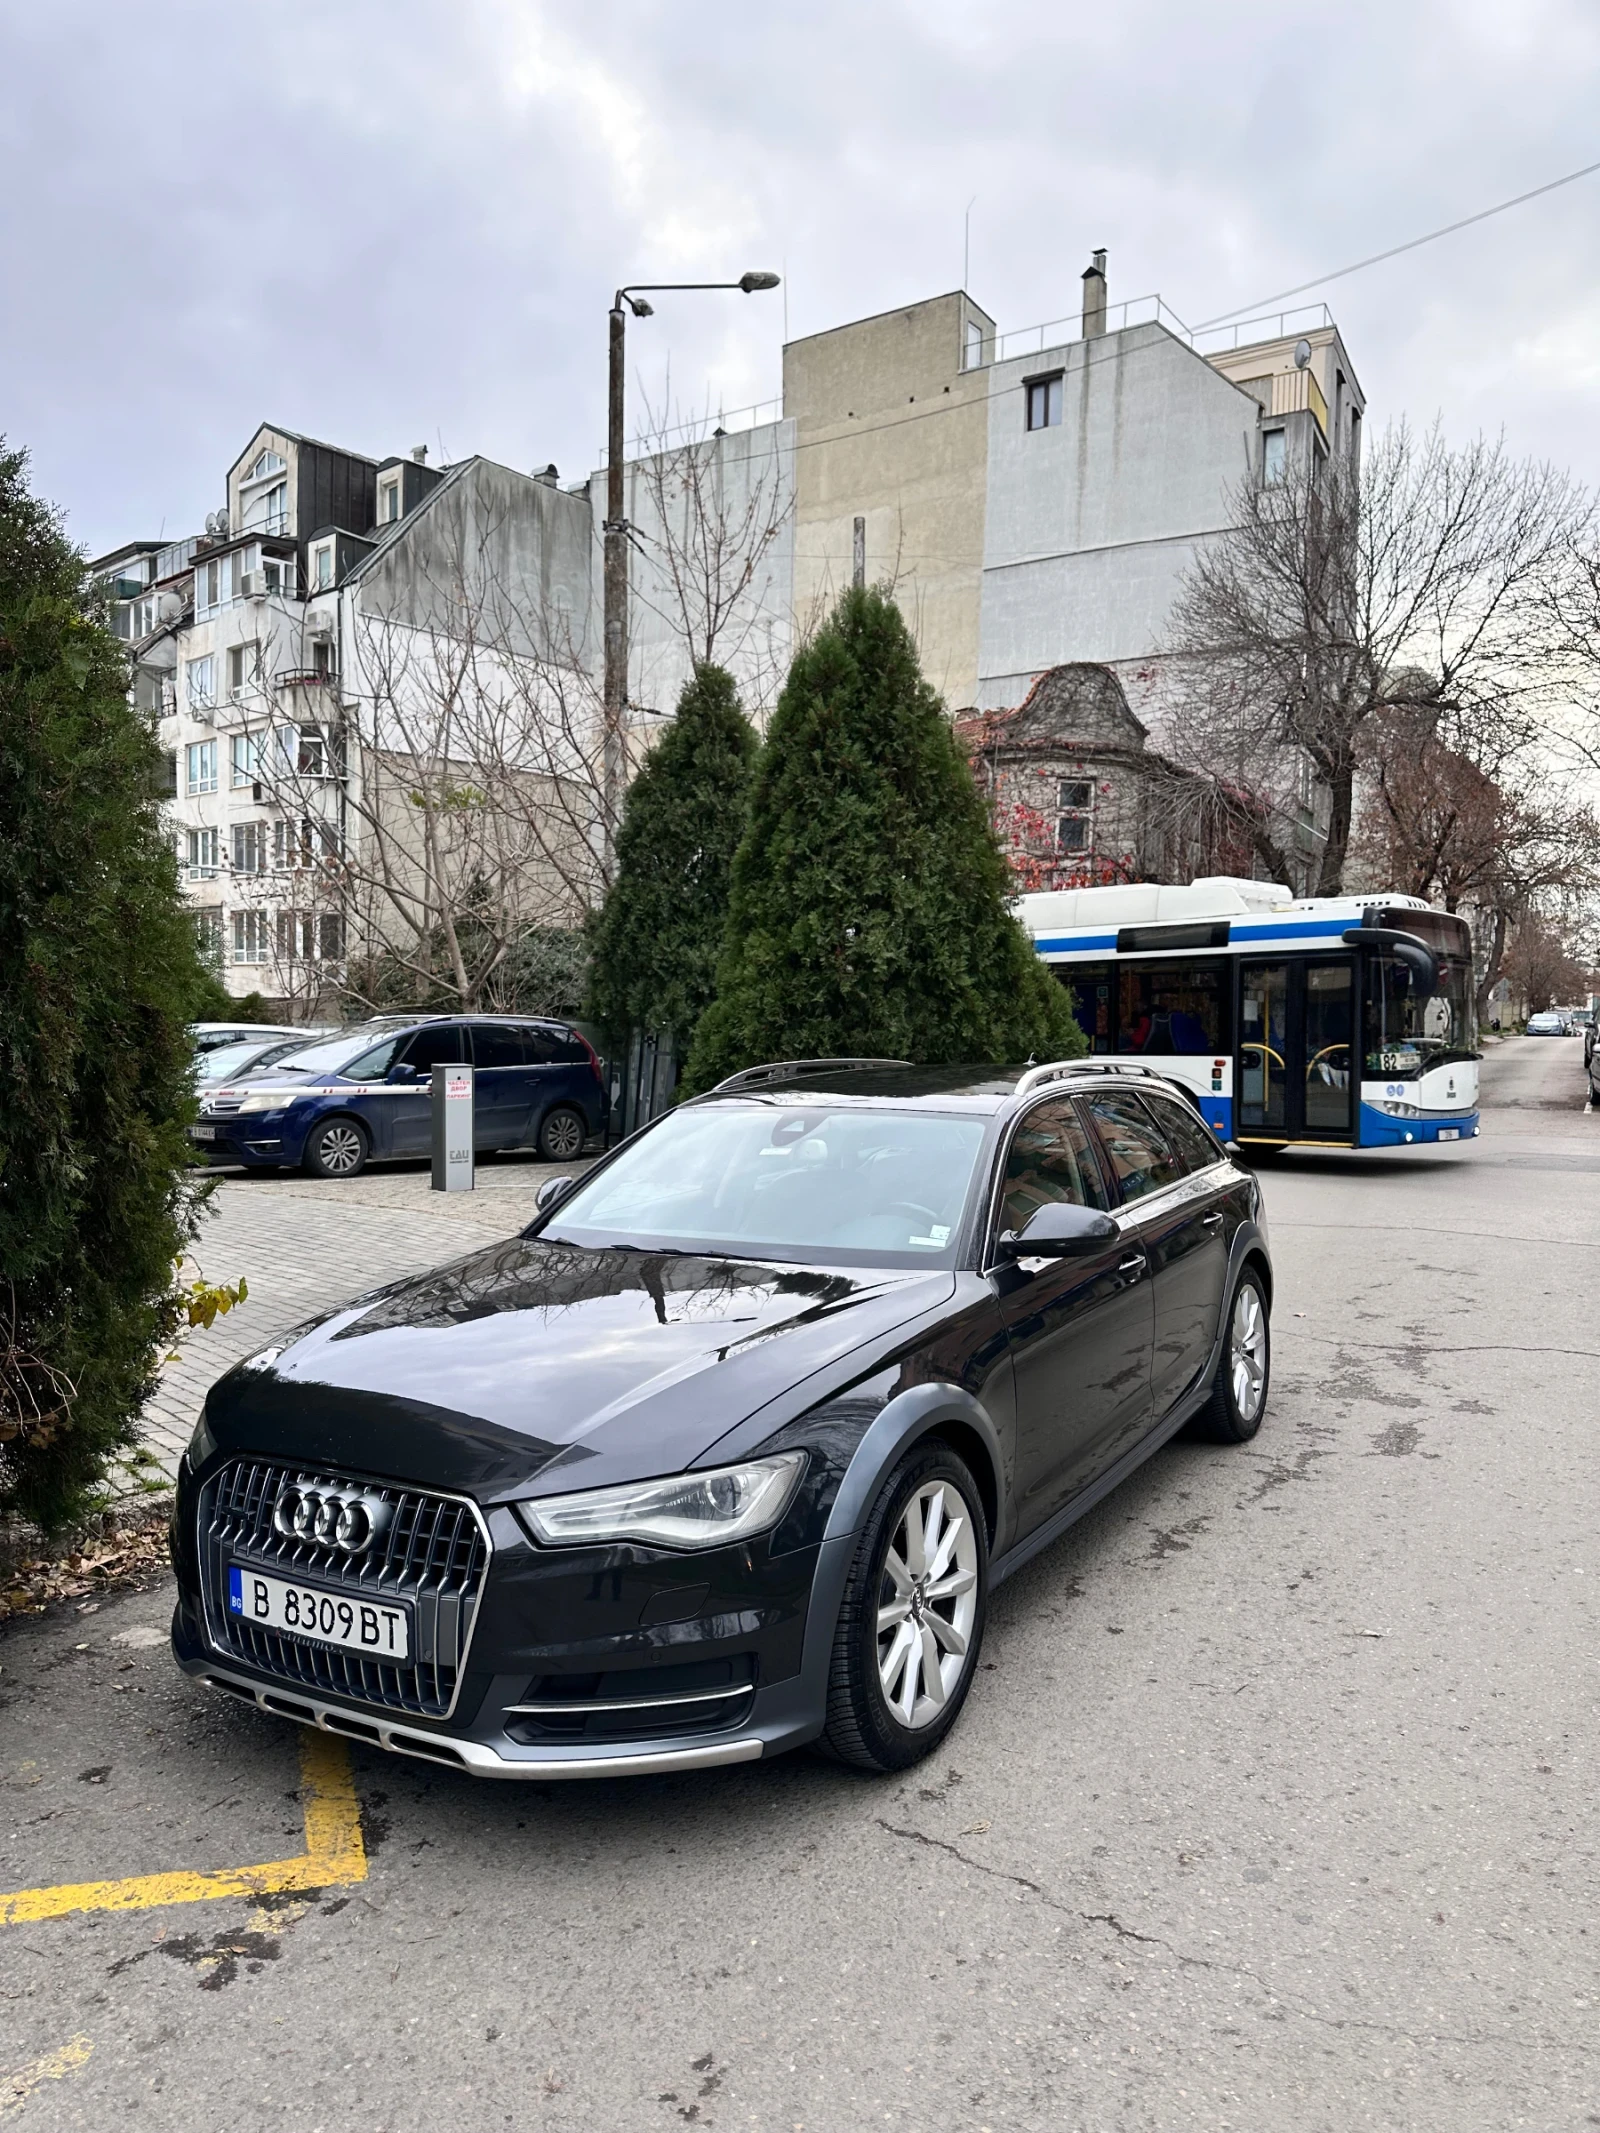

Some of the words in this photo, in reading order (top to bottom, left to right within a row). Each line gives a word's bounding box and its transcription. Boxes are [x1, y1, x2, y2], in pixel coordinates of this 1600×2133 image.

[1383, 1053, 1398, 1071] 82
[231, 1595, 242, 1609] BG
[253, 1579, 270, 1618] B
